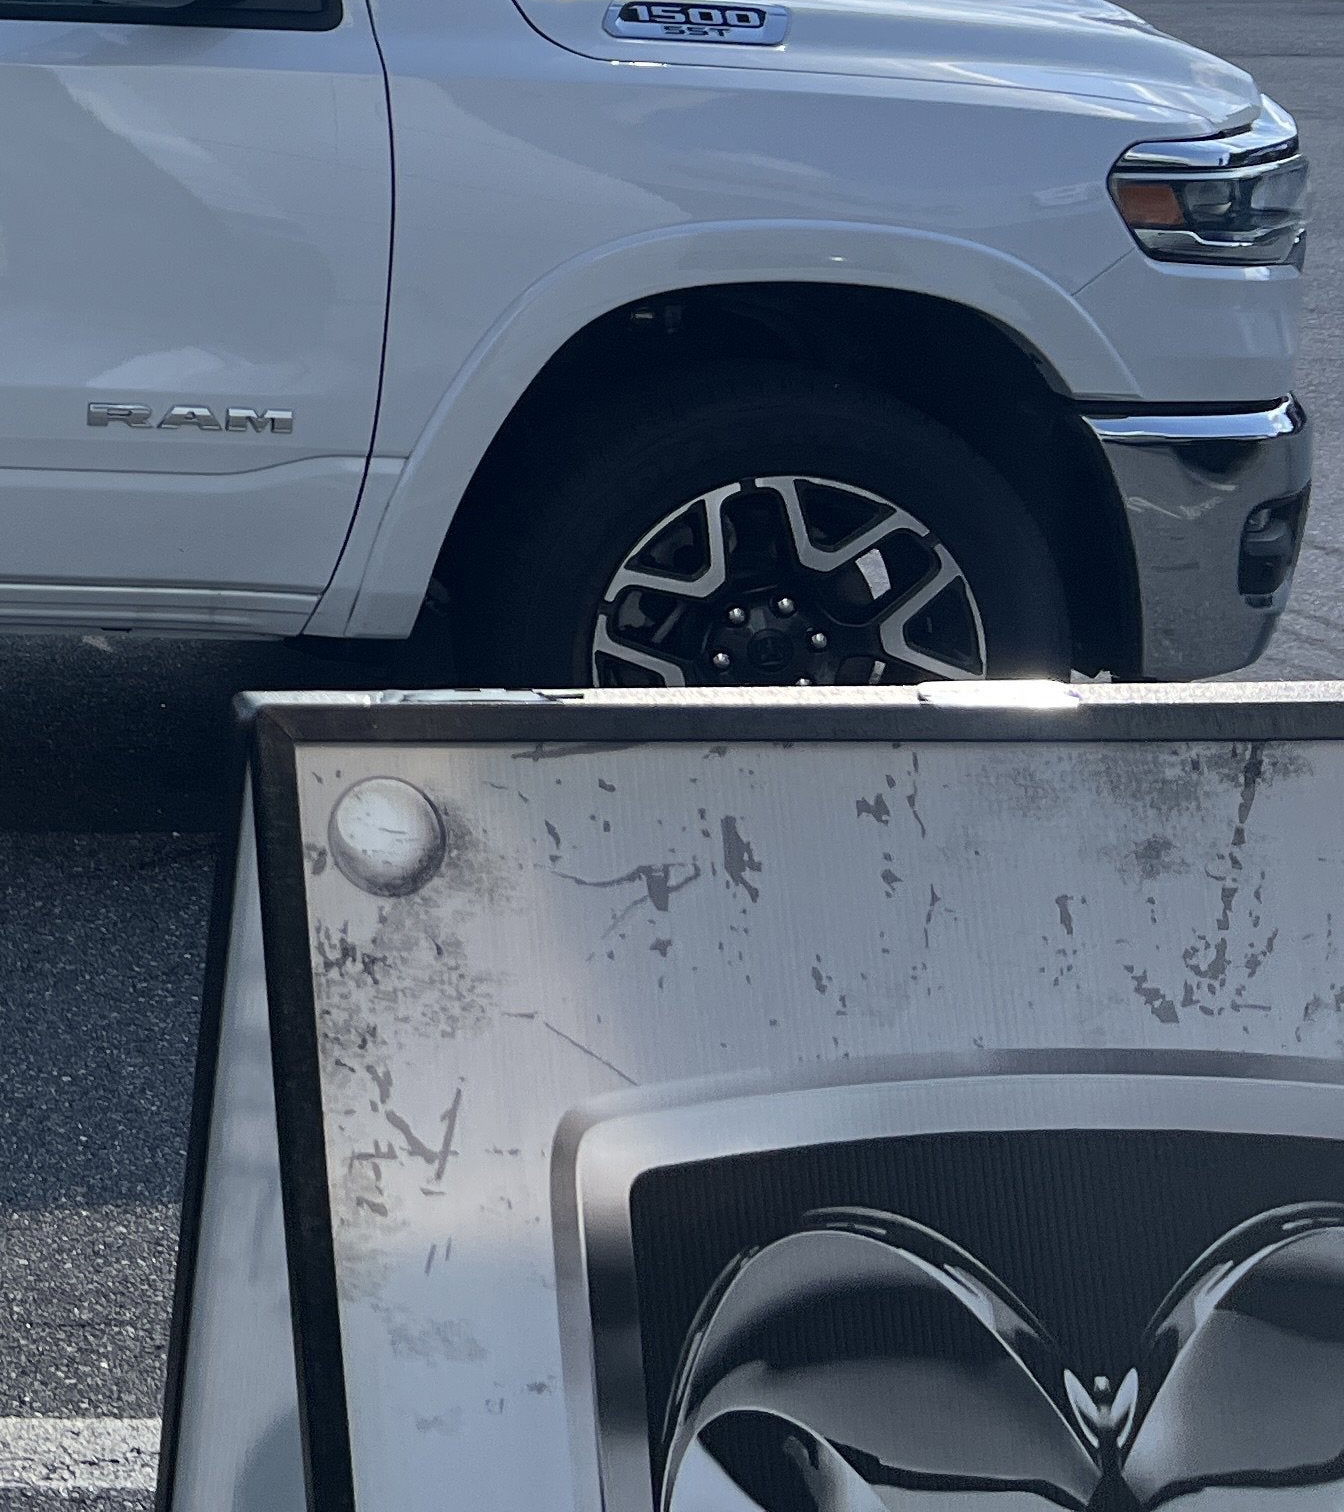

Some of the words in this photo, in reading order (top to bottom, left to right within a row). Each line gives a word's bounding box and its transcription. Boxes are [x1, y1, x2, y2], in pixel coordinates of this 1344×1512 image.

[628, 4, 762, 26] 1500
[663, 25, 731, 38] SST
[86, 401, 294, 435] RAM
